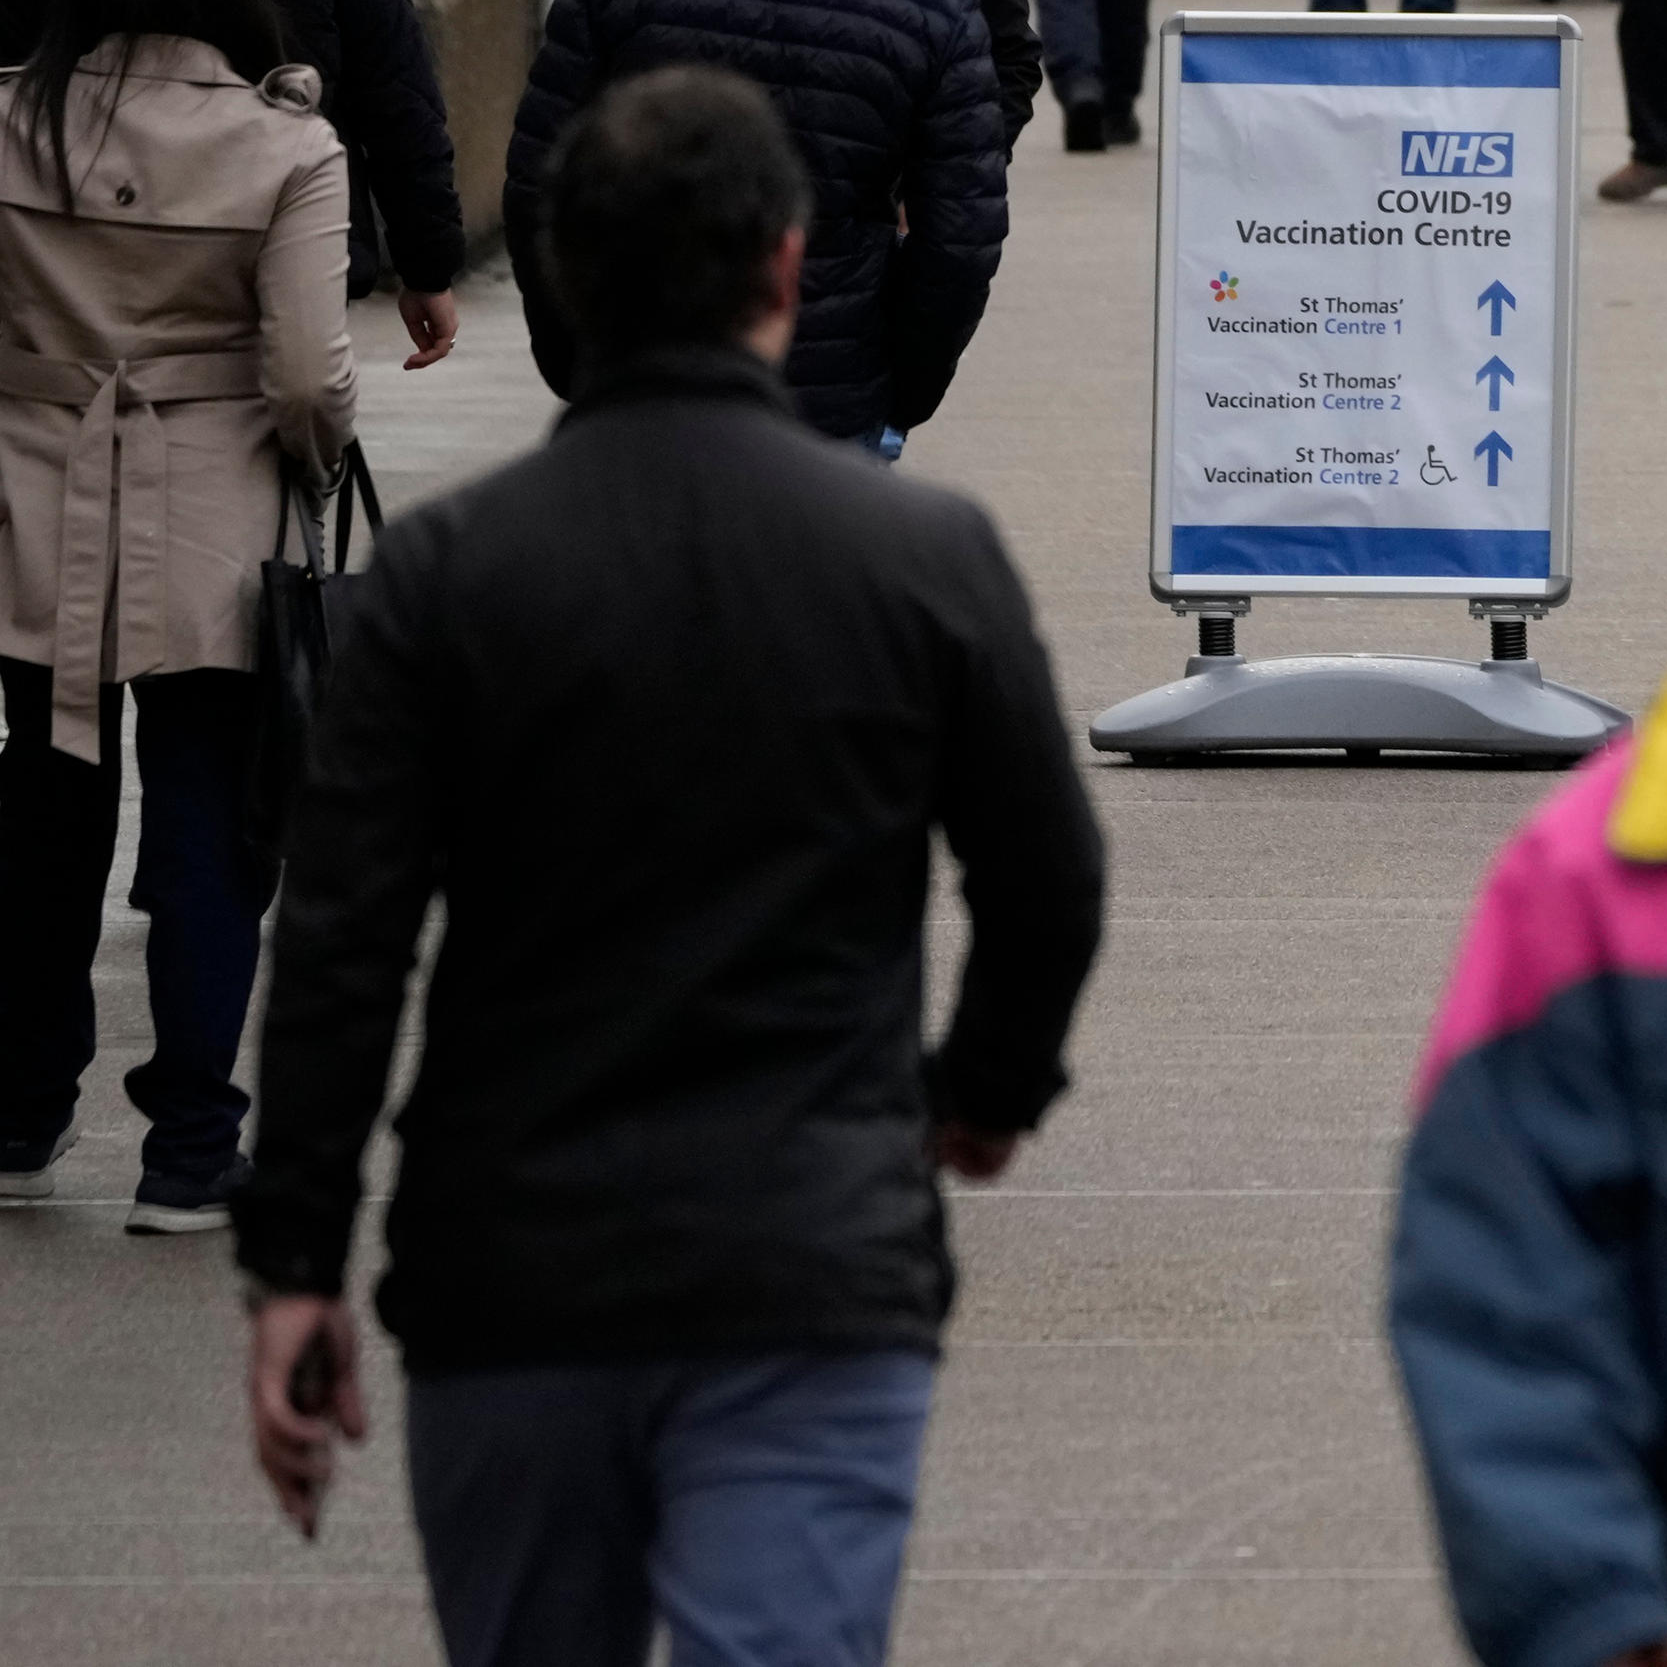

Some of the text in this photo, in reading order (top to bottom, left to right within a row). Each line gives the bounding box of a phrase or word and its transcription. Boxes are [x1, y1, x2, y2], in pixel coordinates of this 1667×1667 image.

[1404, 135, 1510, 175] NHS
[1377, 189, 1512, 216] COVID-19
[1236, 220, 1511, 248] Vaccination Centre
[1300, 296, 1319, 315] St
[1207, 316, 1402, 337] Vaccination Centre 1
[1298, 372, 1317, 390] St
[1205, 391, 1401, 412] Vaccination Centre 2
[1295, 447, 1315, 465] St
[1203, 466, 1399, 487] Vaccination Centre 2
